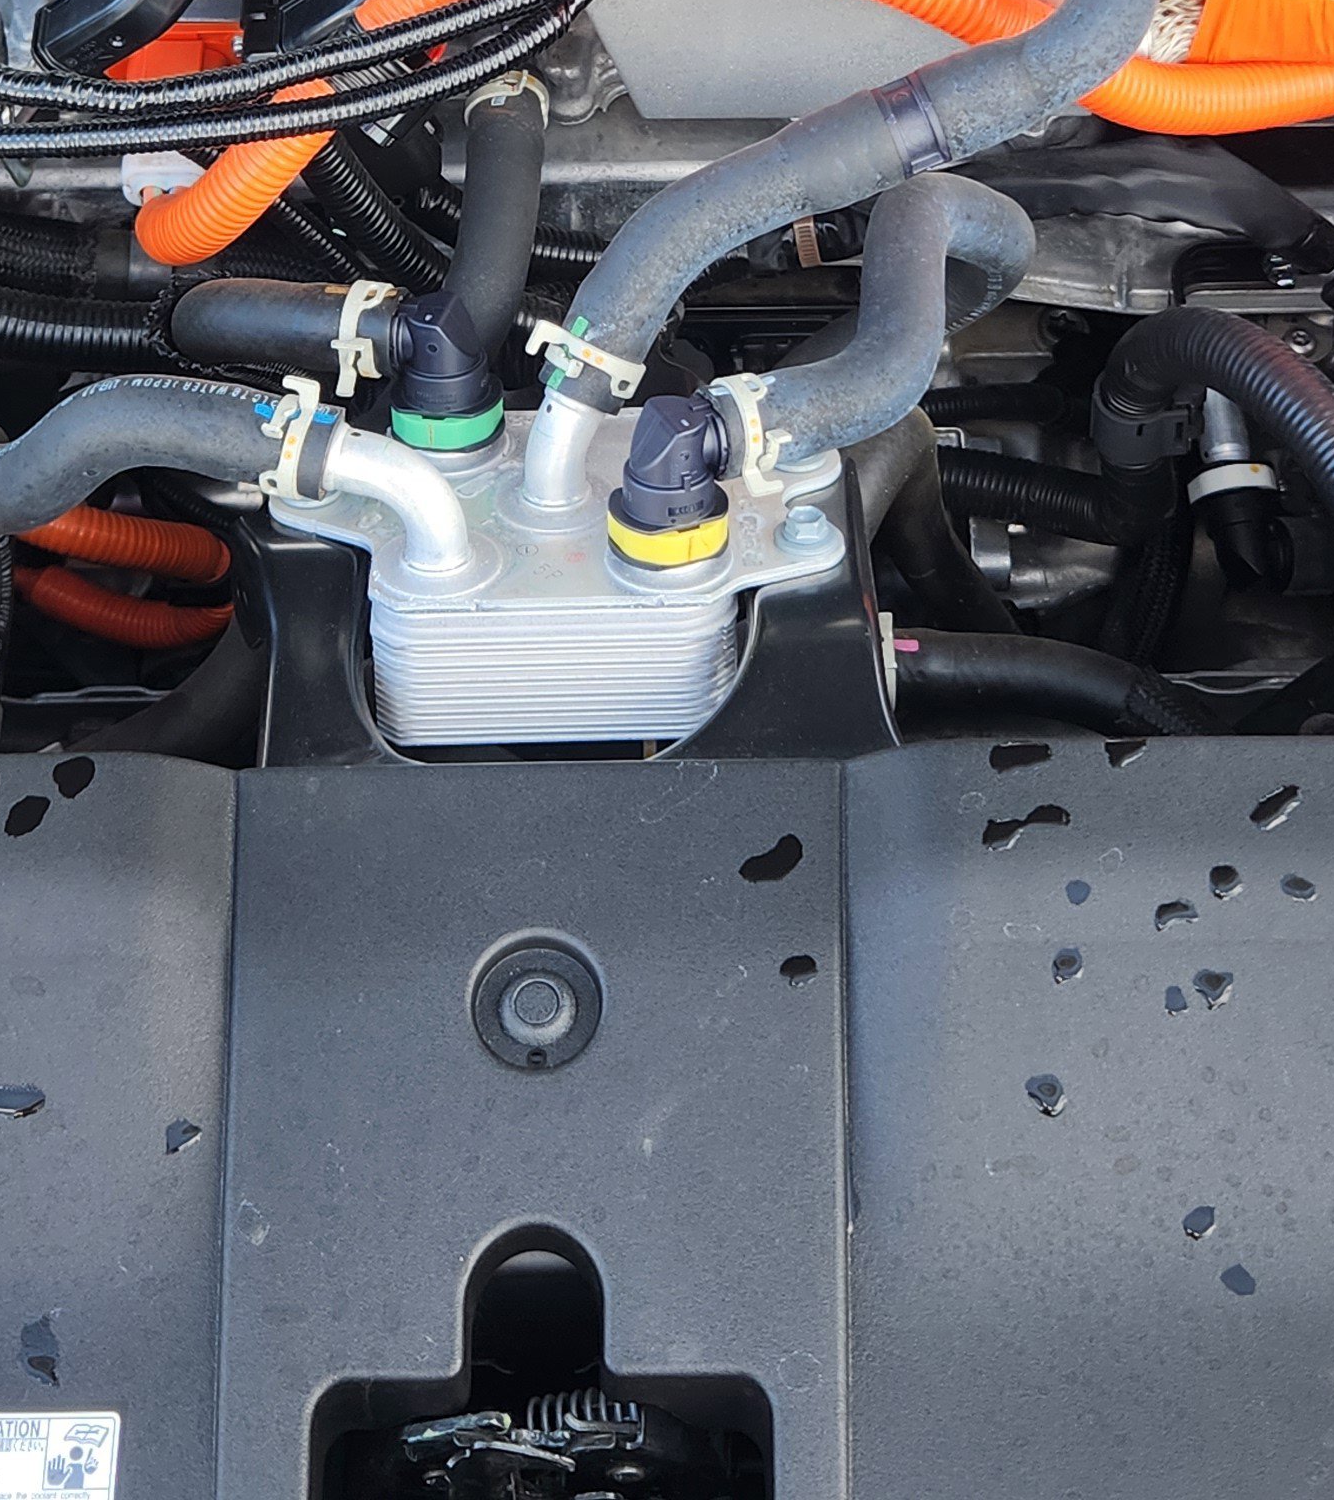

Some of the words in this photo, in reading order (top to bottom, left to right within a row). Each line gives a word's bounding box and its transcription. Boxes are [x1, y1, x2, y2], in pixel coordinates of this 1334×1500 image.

[182, 381, 229, 396] WATER
[16, 1492, 27, 1500] the
[31, 1492, 57, 1500] coolant
[60, 1492, 91, 1500] correctly
